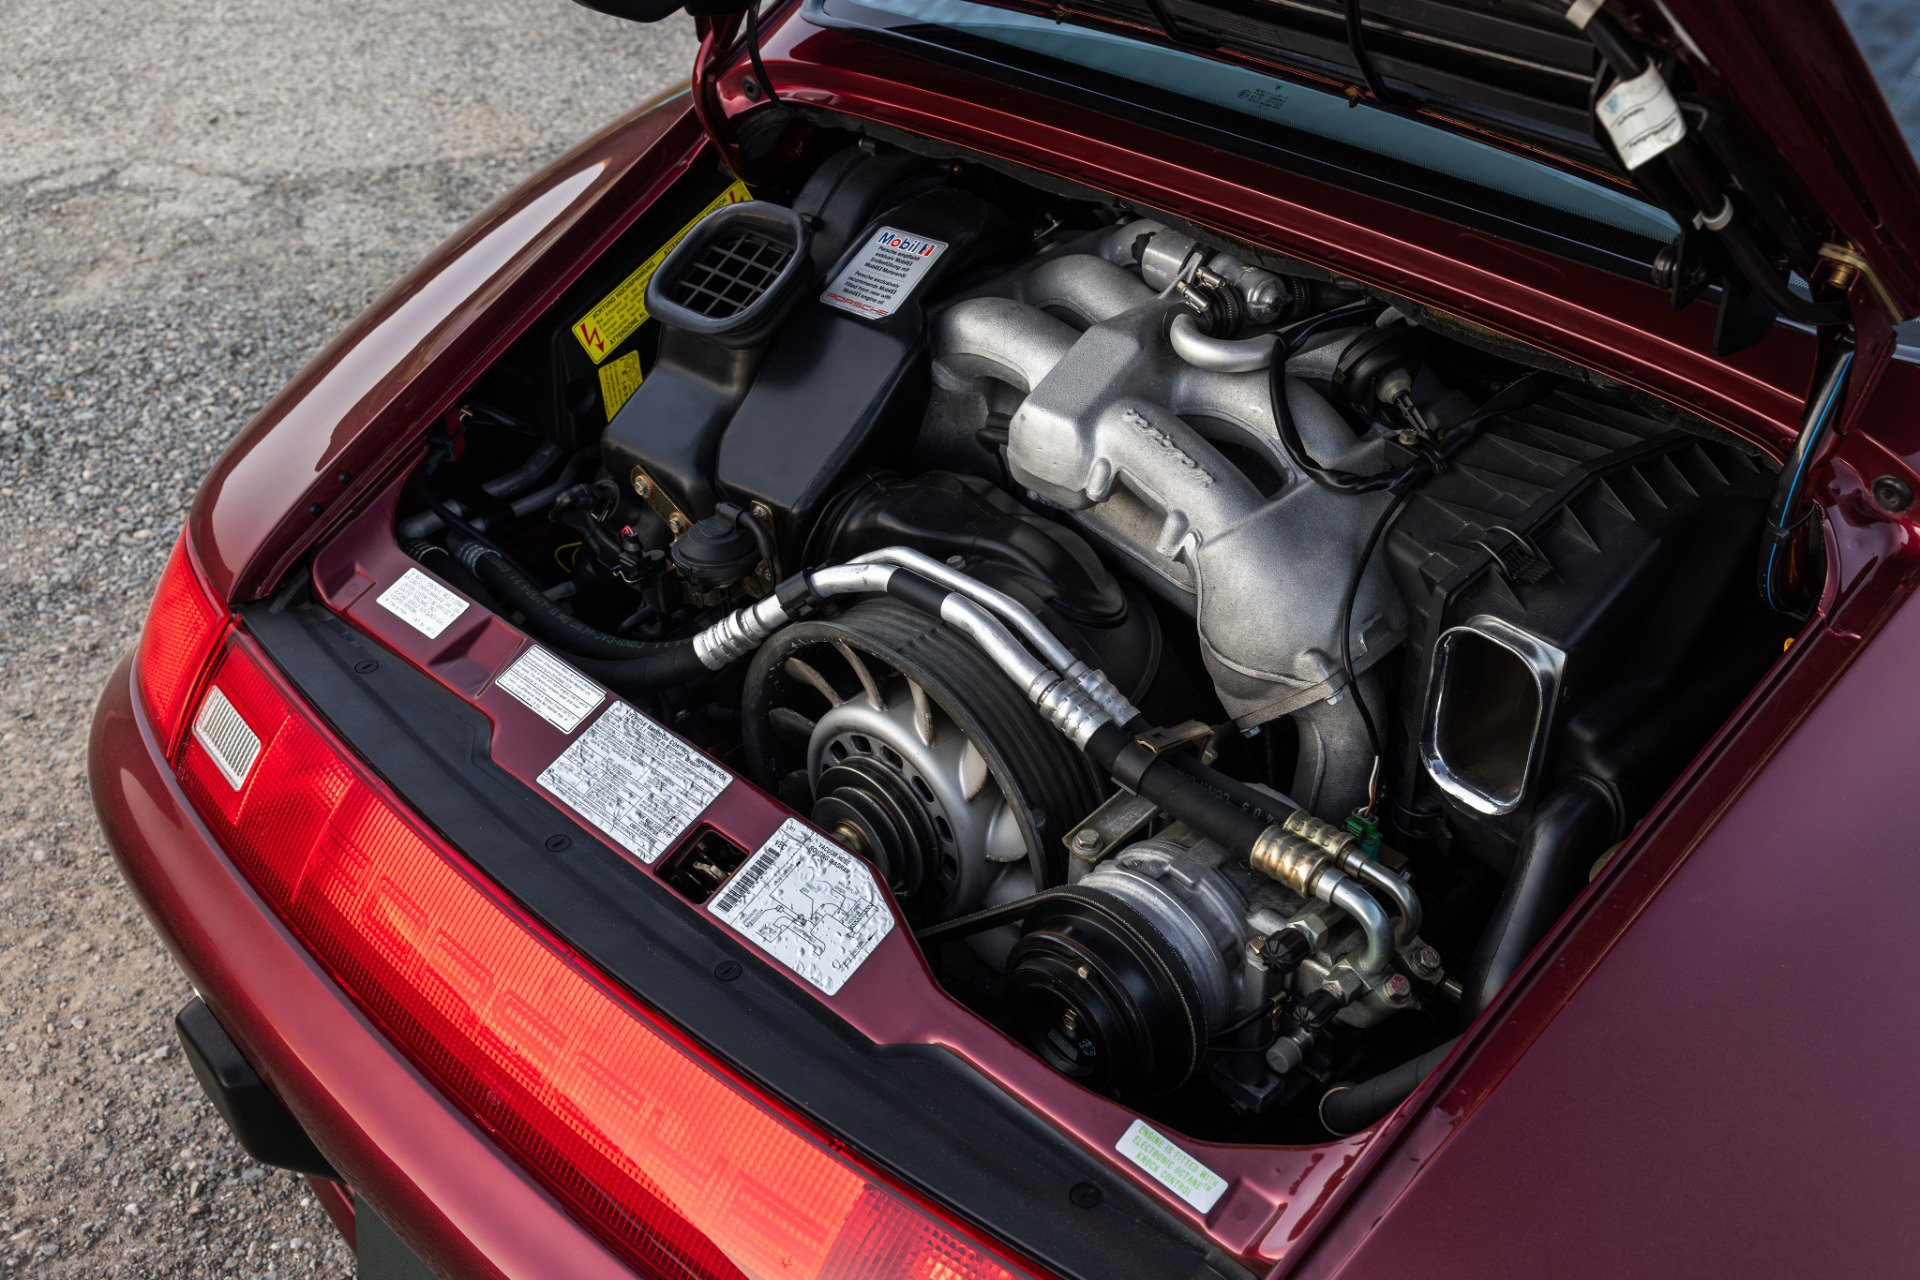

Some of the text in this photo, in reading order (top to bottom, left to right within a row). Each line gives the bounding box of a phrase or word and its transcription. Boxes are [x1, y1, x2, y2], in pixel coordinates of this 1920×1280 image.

[878, 232, 920, 252] Mobil
[592, 296, 616, 318] ACHTUNG
[616, 261, 655, 297] HOCHSPANNUNG
[826, 292, 888, 316] PORSCHE
[669, 739, 690, 755] CONTROL
[695, 757, 727, 781] INFORMATION
[774, 840, 787, 851] VEC
[809, 845, 851, 874] ROUTING DIAGRAM
[818, 842, 851, 866] VACUUM HOSE
[318, 822, 830, 1272] PORSCHE
[1133, 1135, 1173, 1169] ELECTRONIC
[1138, 1126, 1219, 1187] ENGINE IS FITTED WITH
[1136, 1152, 1192, 1198] KNOCK CONTROL
